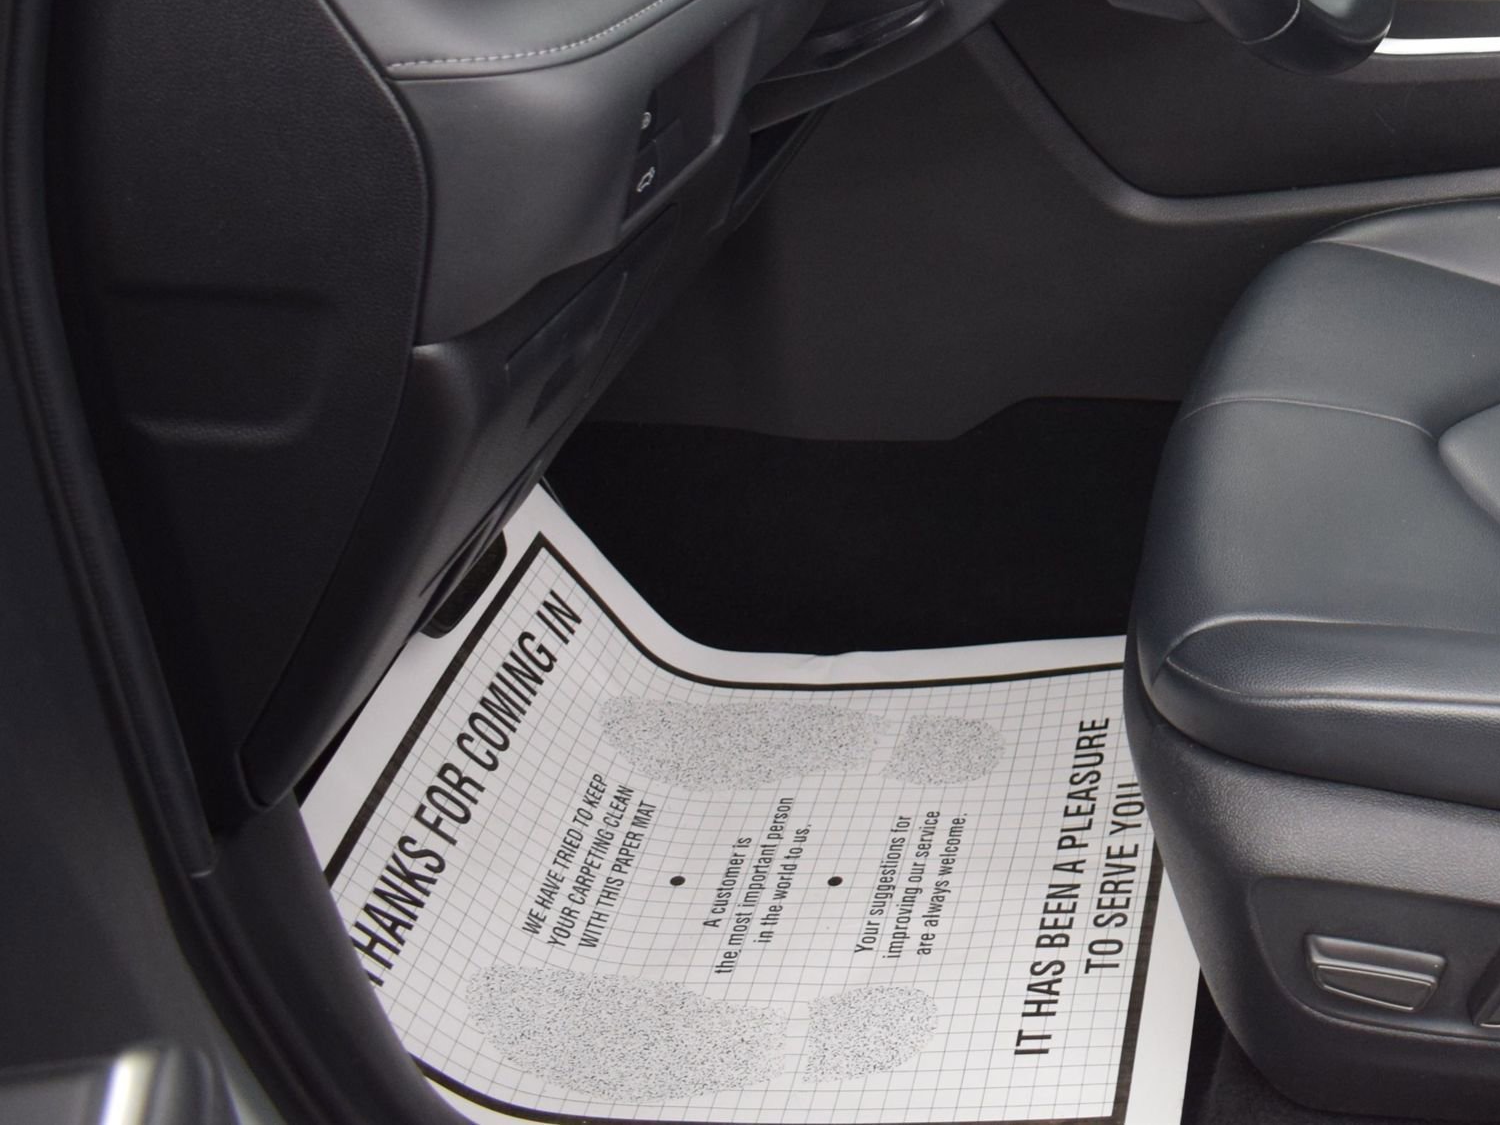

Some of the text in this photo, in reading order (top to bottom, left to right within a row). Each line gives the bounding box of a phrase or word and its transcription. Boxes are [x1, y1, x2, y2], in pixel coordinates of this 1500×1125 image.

[349, 589, 583, 987] HANKS FOR COMING IN
[766, 797, 794, 840] person
[521, 773, 608, 935] WE HAVE TRIED TO KEEP
[547, 785, 634, 947] YOUR CARPETING CLEAN
[578, 800, 657, 948] WITH THIS PAPER MAT
[702, 837, 752, 928] A customer is
[737, 844, 777, 907] important
[773, 863, 798, 900] world
[784, 847, 804, 860] to
[854, 815, 912, 953] Your suggestions for
[882, 811, 940, 958] improving our service
[917, 813, 968, 955] are always welcome.
[1014, 717, 1110, 1056] IT HAS BEEN A PLEASURE
[1093, 843, 1140, 928] SERVE
[728, 912, 753, 946] most
[753, 930, 774, 943] in
[760, 904, 783, 926] the
[1084, 938, 1124, 975] TO
